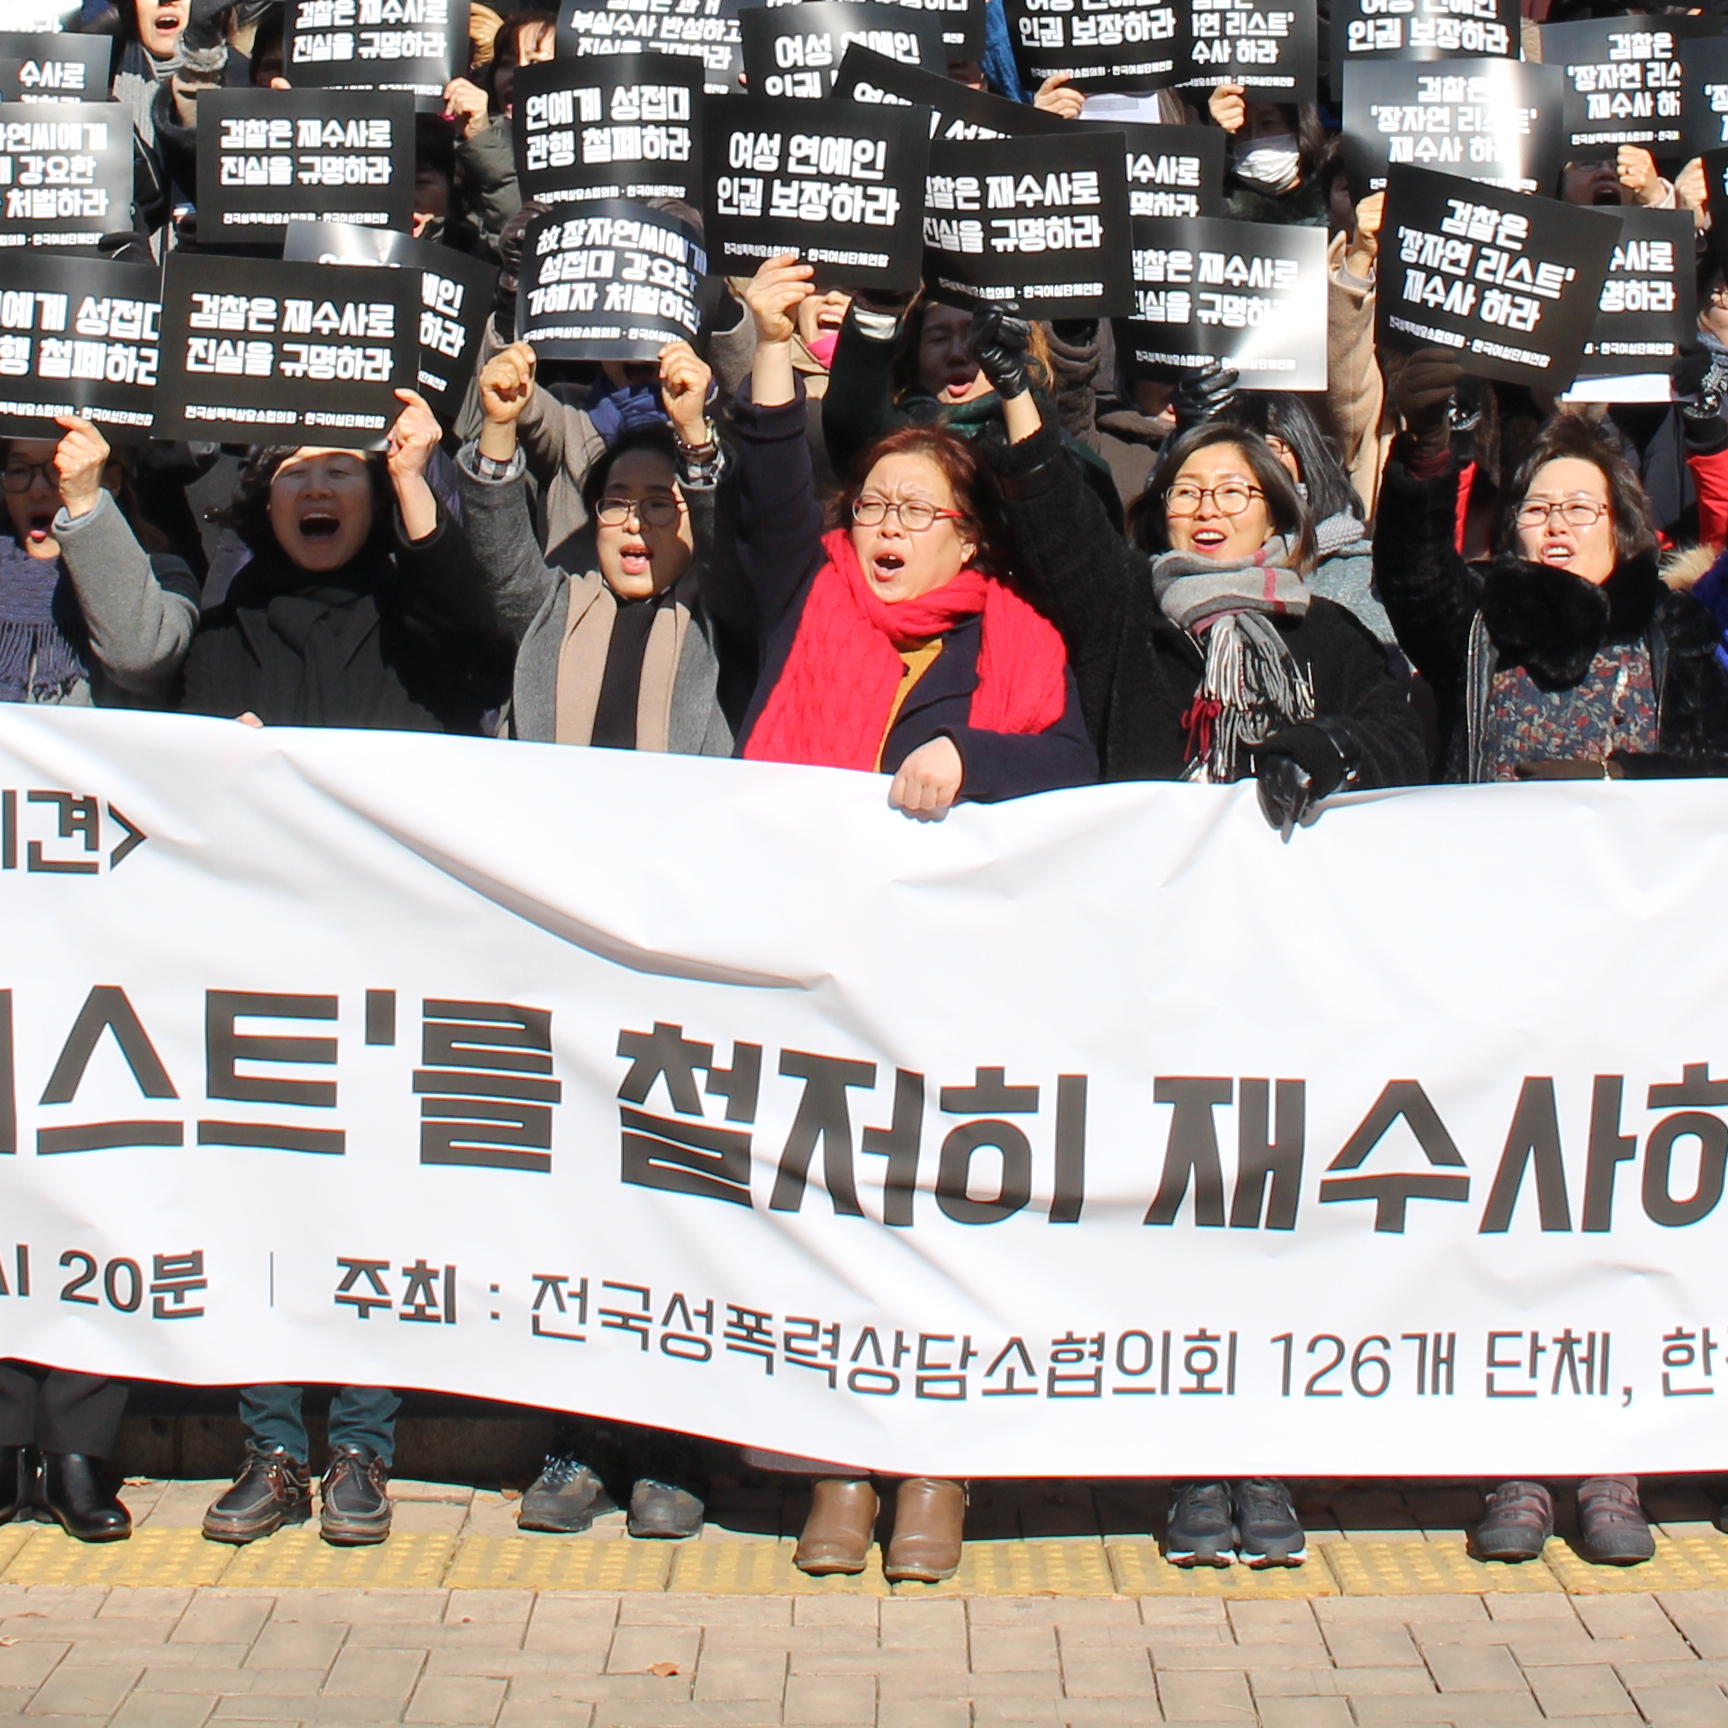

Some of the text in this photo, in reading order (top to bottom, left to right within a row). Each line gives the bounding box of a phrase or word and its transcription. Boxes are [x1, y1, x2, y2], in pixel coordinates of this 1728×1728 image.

[23, 154, 95, 184] 강요한
[7, 187, 109, 219] 처벌하라
[1442, 200, 1528, 251] 검찰은
[190, 294, 394, 337] 검찰은 재수사로
[1403, 268, 1540, 331] 재수사 하라
[187, 338, 393, 381] 진실을 규명하라
[616, 1022, 1087, 1227] 철저히
[59, 1250, 207, 1319] 20분
[335, 1258, 456, 1324] 주최
[532, 1274, 1237, 1401] 전국성폭력상담소협의회
[1271, 1333, 1455, 1397] 126개
[1487, 1329, 1632, 1407] 단체,
